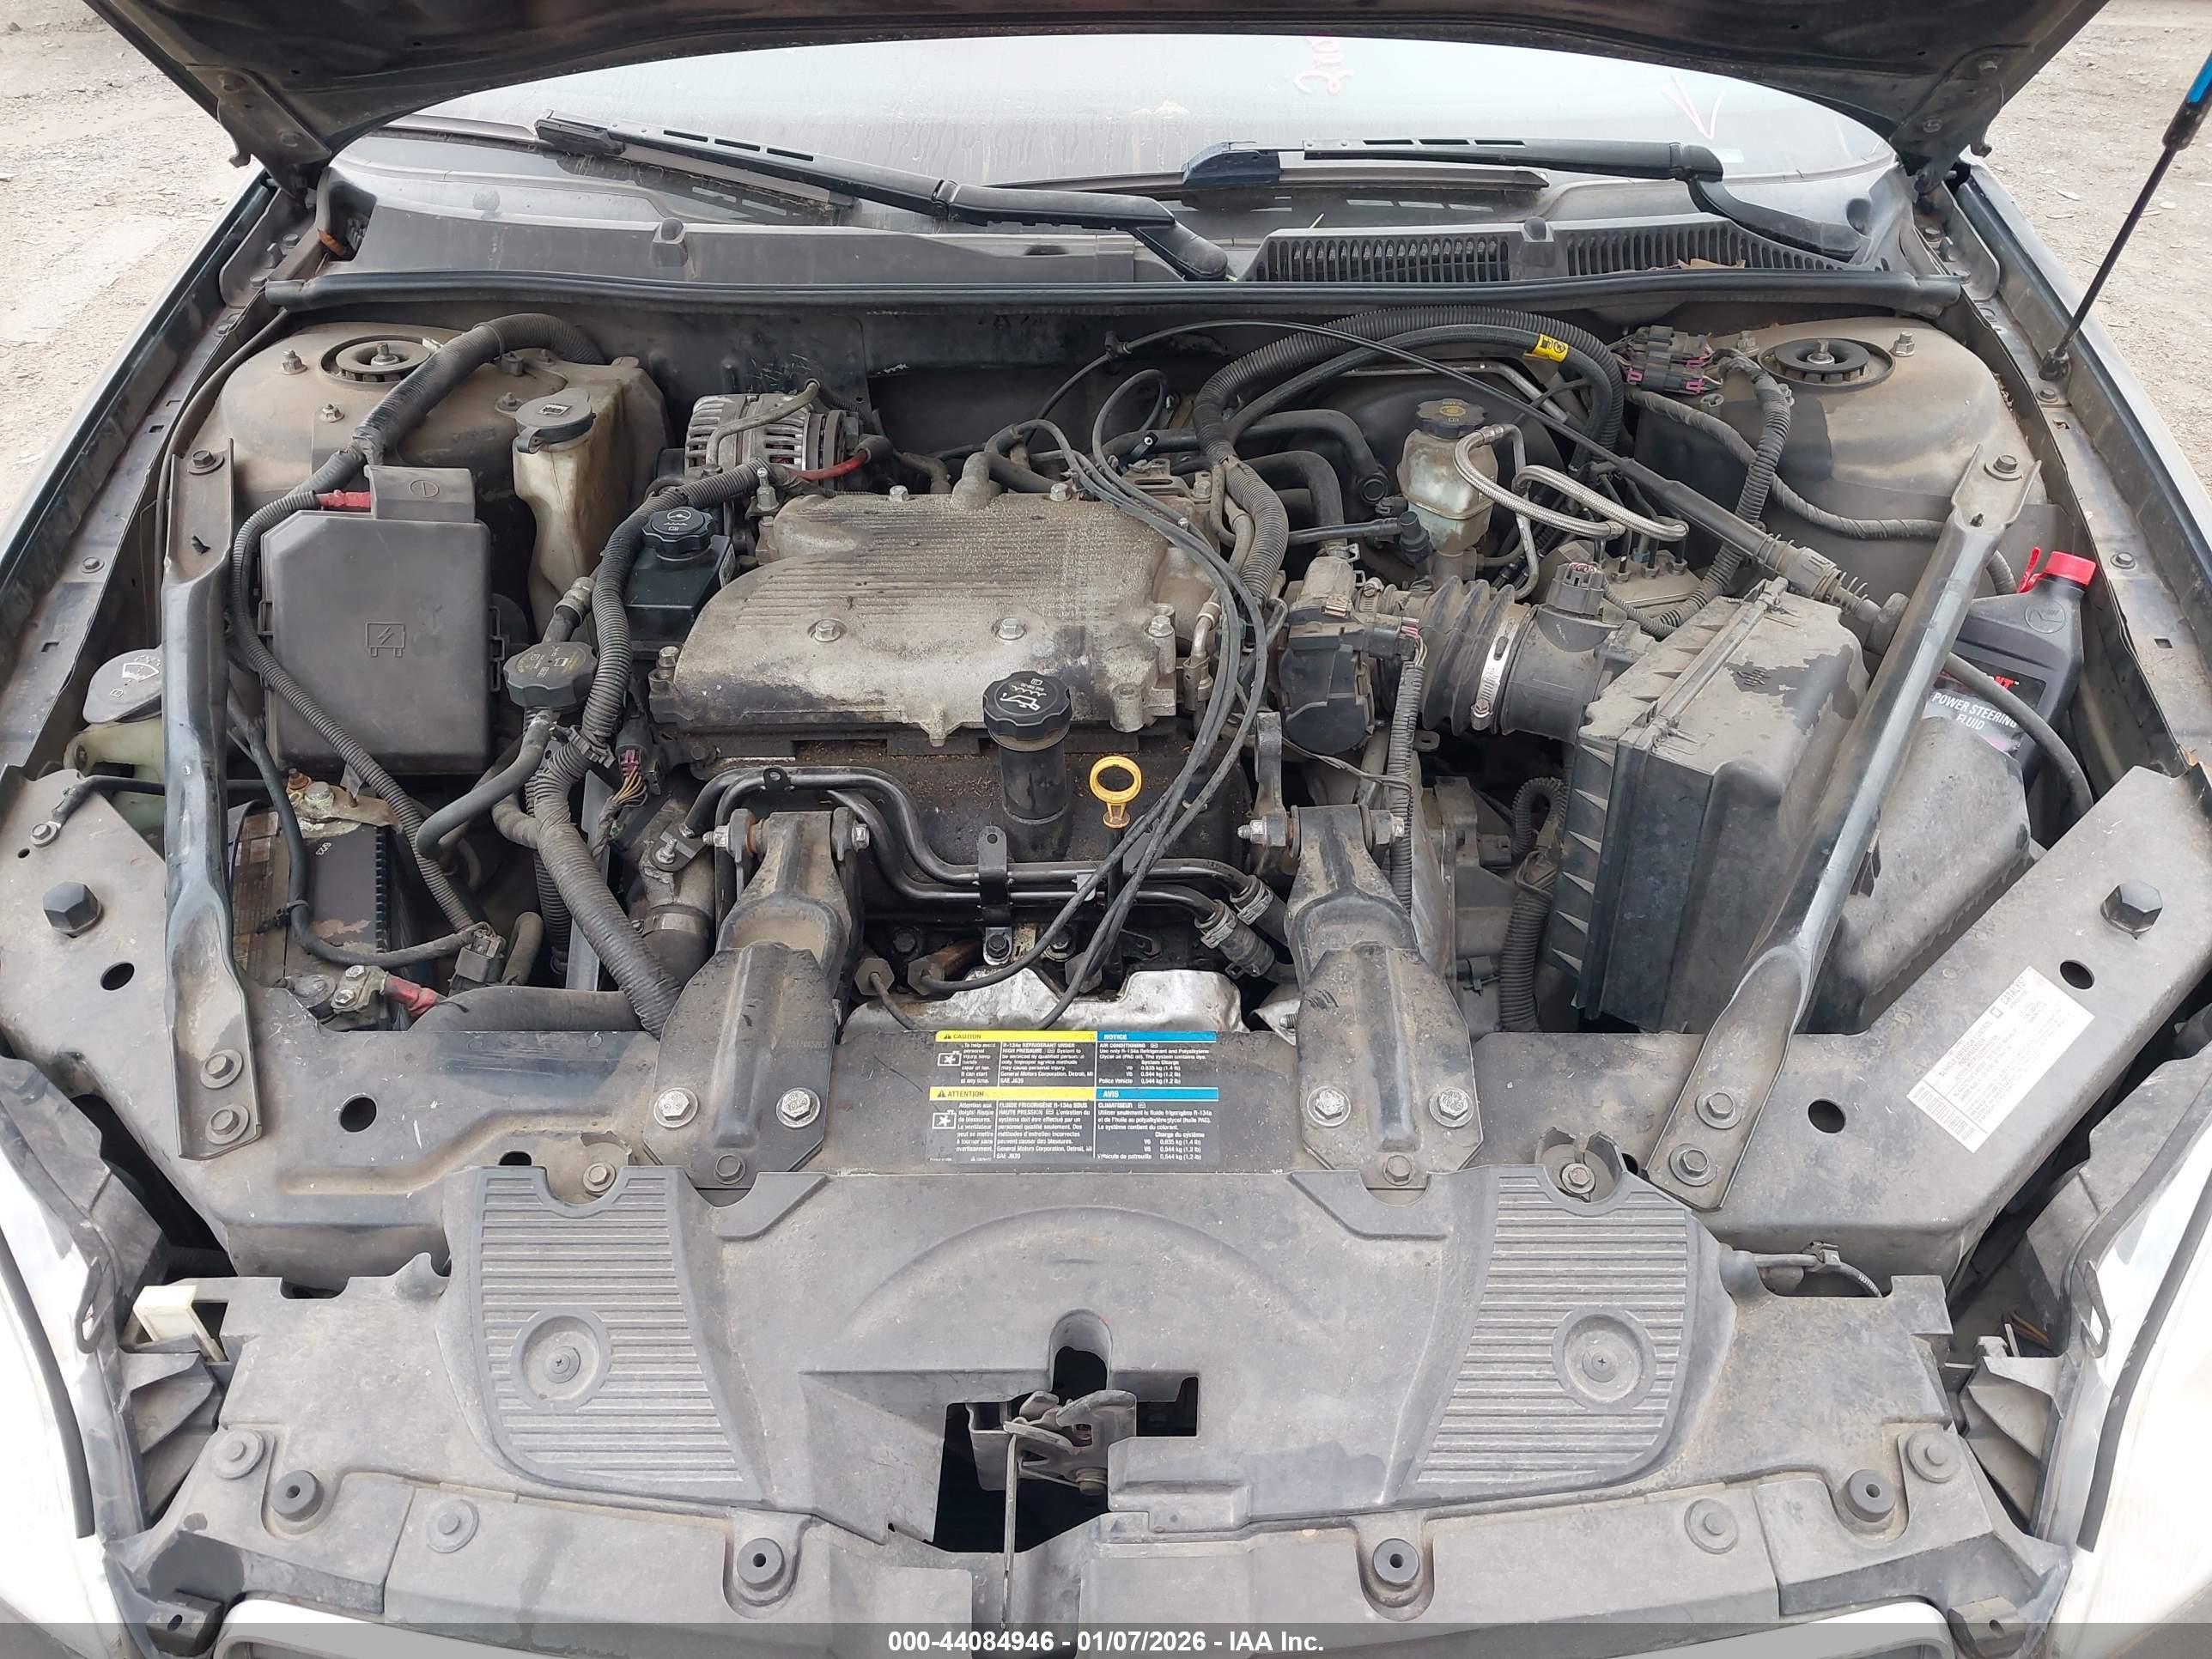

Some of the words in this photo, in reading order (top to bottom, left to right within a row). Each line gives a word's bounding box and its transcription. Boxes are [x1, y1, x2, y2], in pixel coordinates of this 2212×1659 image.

[1932, 693, 1970, 711] POWER
[1970, 703, 2017, 728] STEERING
[1956, 714, 1984, 730] FLUID
